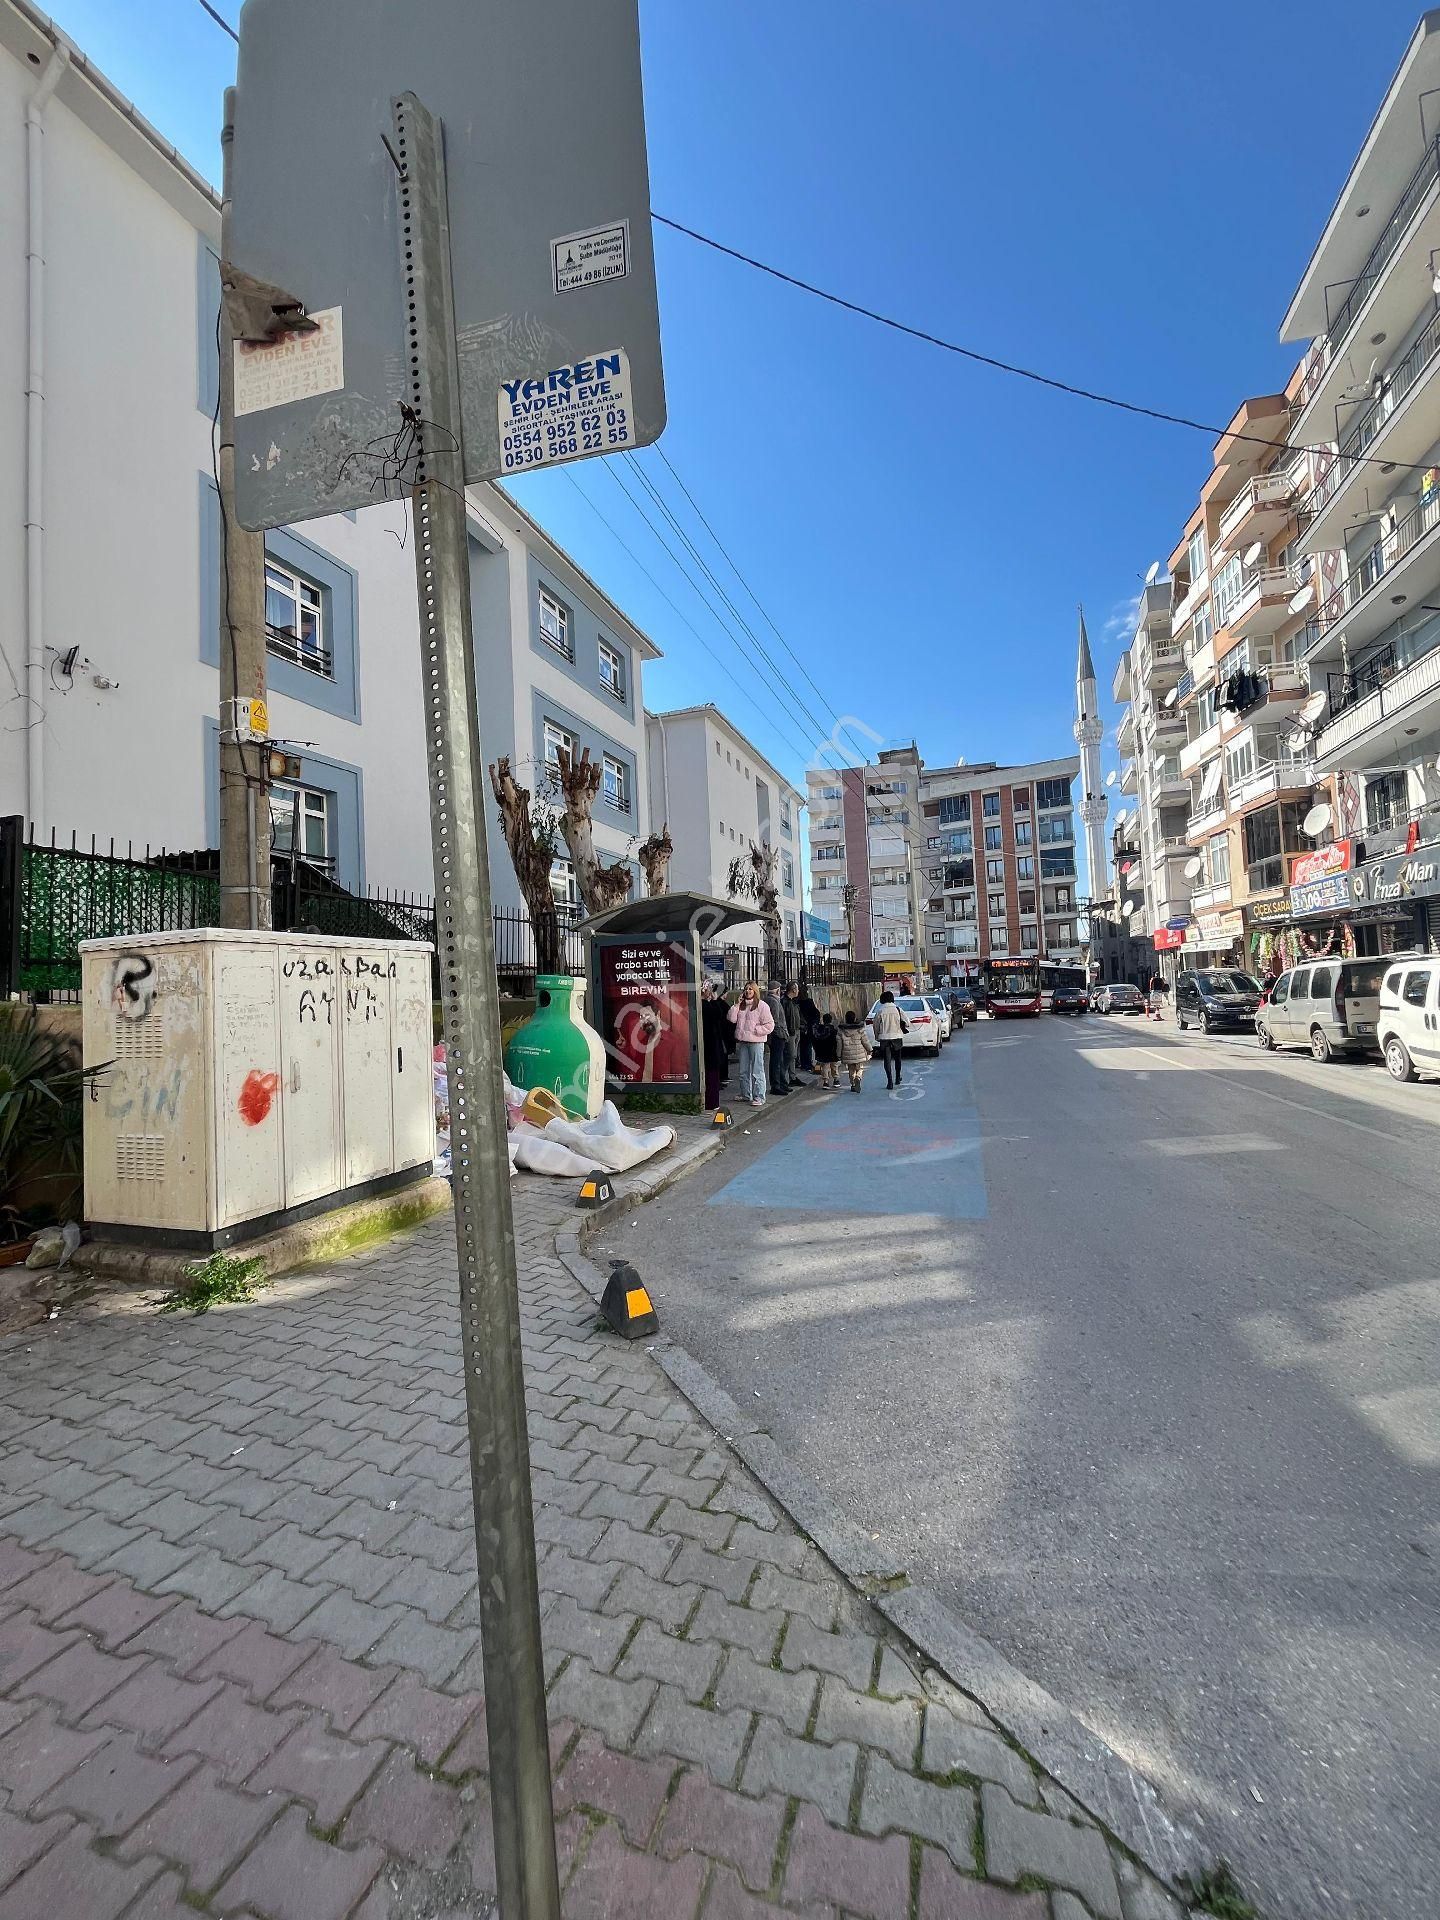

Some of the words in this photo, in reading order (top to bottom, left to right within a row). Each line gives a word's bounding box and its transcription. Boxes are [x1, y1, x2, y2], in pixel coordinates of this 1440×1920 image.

[244, 345, 296, 368] EVDEN
[301, 335, 331, 352] EVE
[501, 354, 621, 404] YAREN
[512, 390, 571, 417] EVDEN
[578, 381, 611, 400] EVE
[596, 392, 623, 404] ARASI
[503, 429, 542, 451] 0554
[546, 421, 577, 441] 952
[581, 414, 602, 432] 62
[606, 409, 627, 427] 03
[505, 446, 543, 468] 0530
[549, 438, 578, 458] 568
[582, 431, 603, 450] 22
[608, 426, 628, 444] 55
[1404, 861, 1434, 883] Man
[1253, 903, 1272, 918] ÇİÇEK
[615, 960, 641, 969] araba
[643, 958, 670, 968] sahibi
[621, 950, 637, 959] Sizi
[650, 950, 661, 958] ve
[616, 970, 653, 982] yapacak
[655, 970, 670, 979] biri
